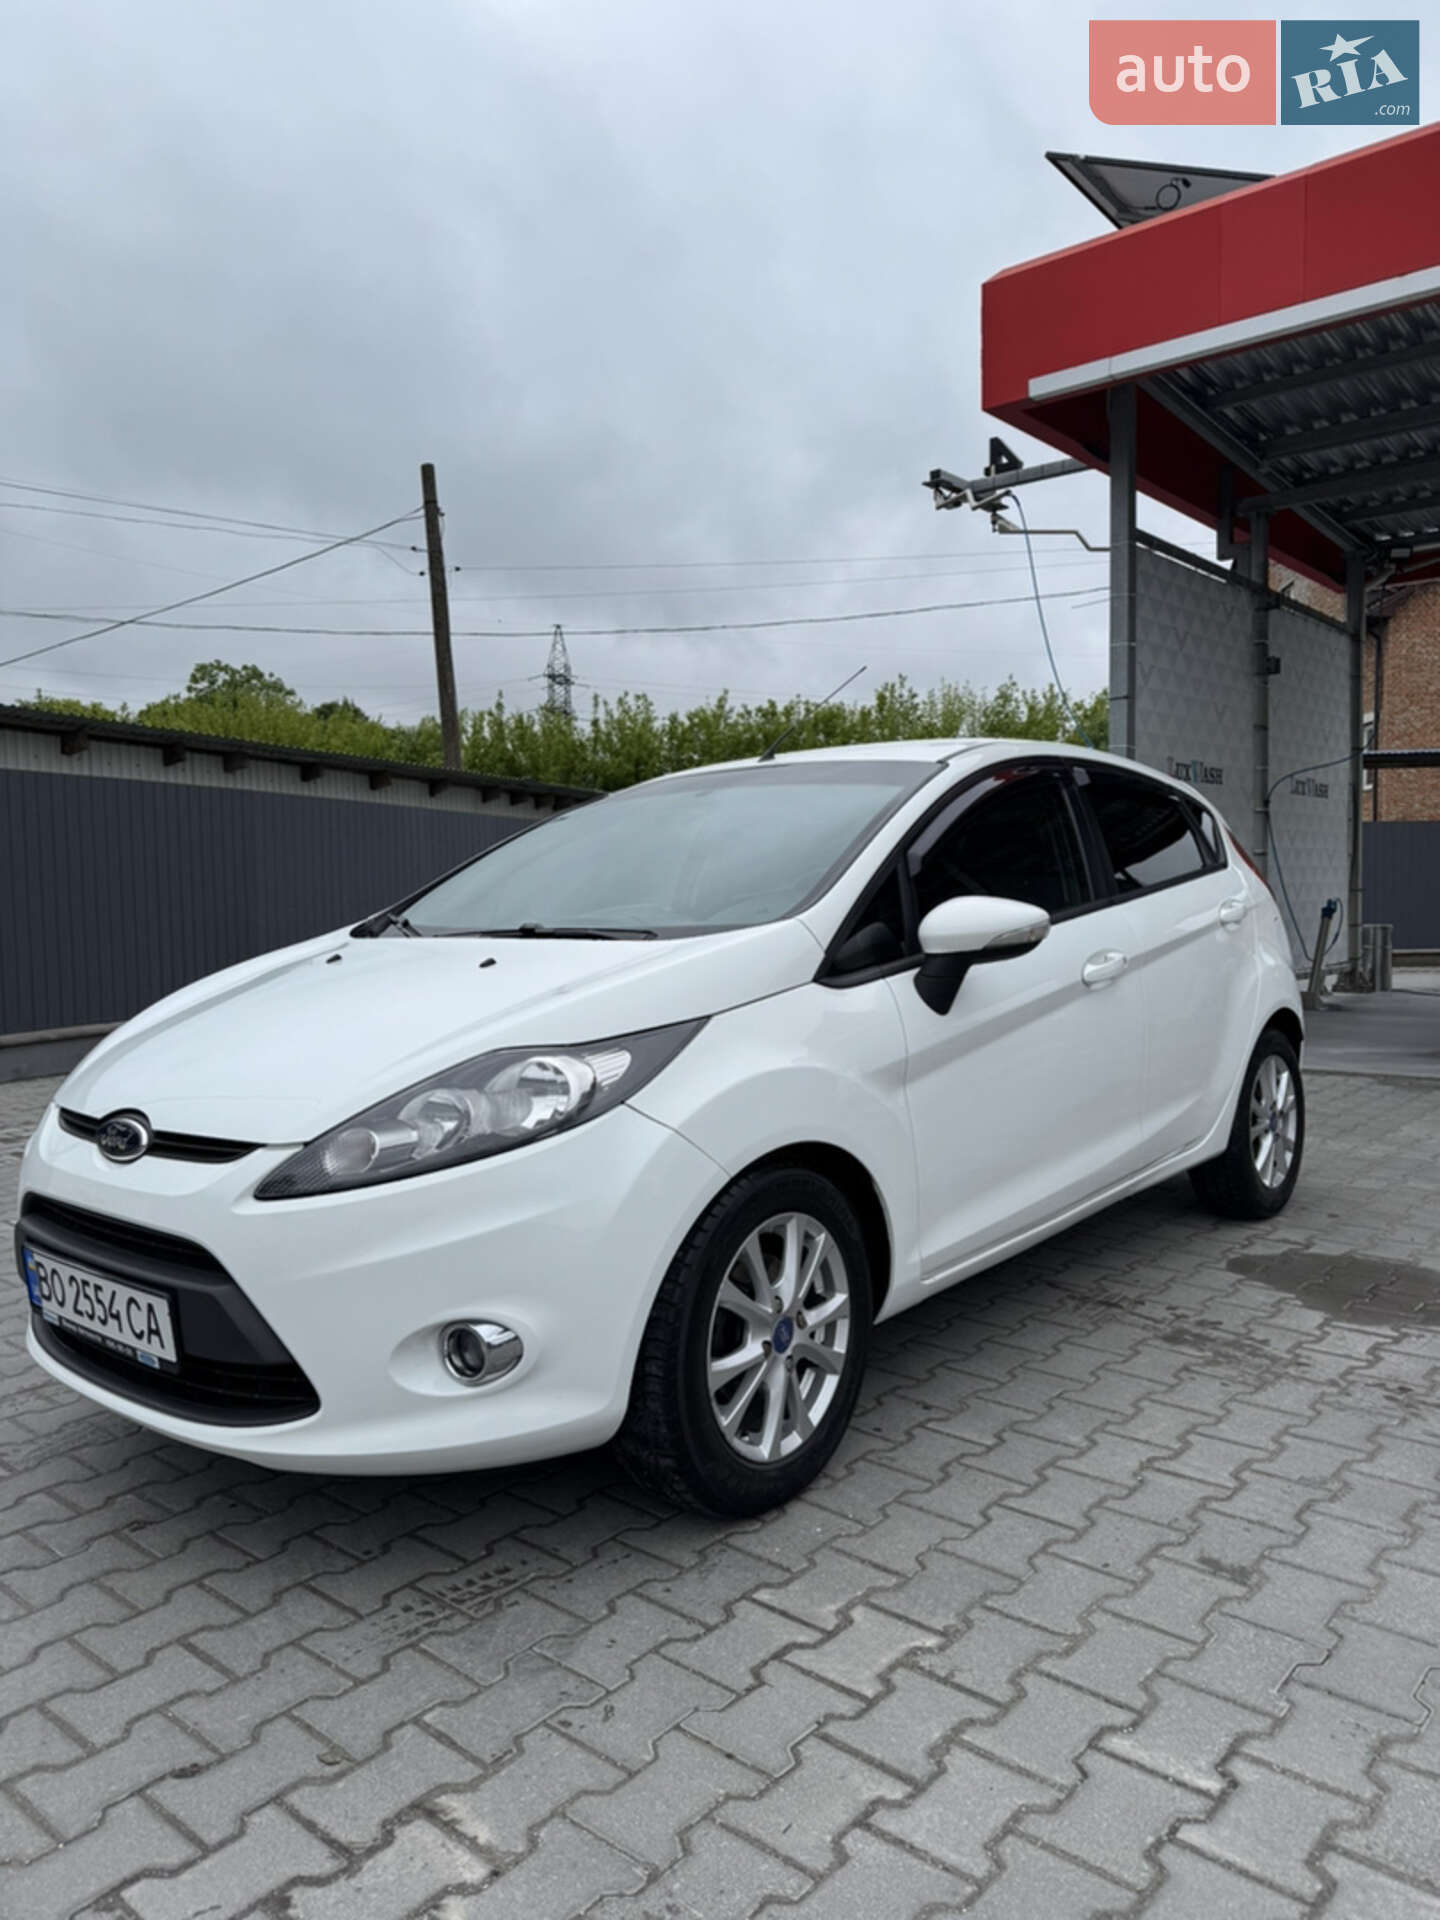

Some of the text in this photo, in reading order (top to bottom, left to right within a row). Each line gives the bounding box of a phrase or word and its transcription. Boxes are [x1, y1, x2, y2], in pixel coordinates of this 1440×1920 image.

[35, 1260, 66, 1309] BO
[69, 1274, 123, 1334] 2554
[126, 1295, 165, 1350] CA
